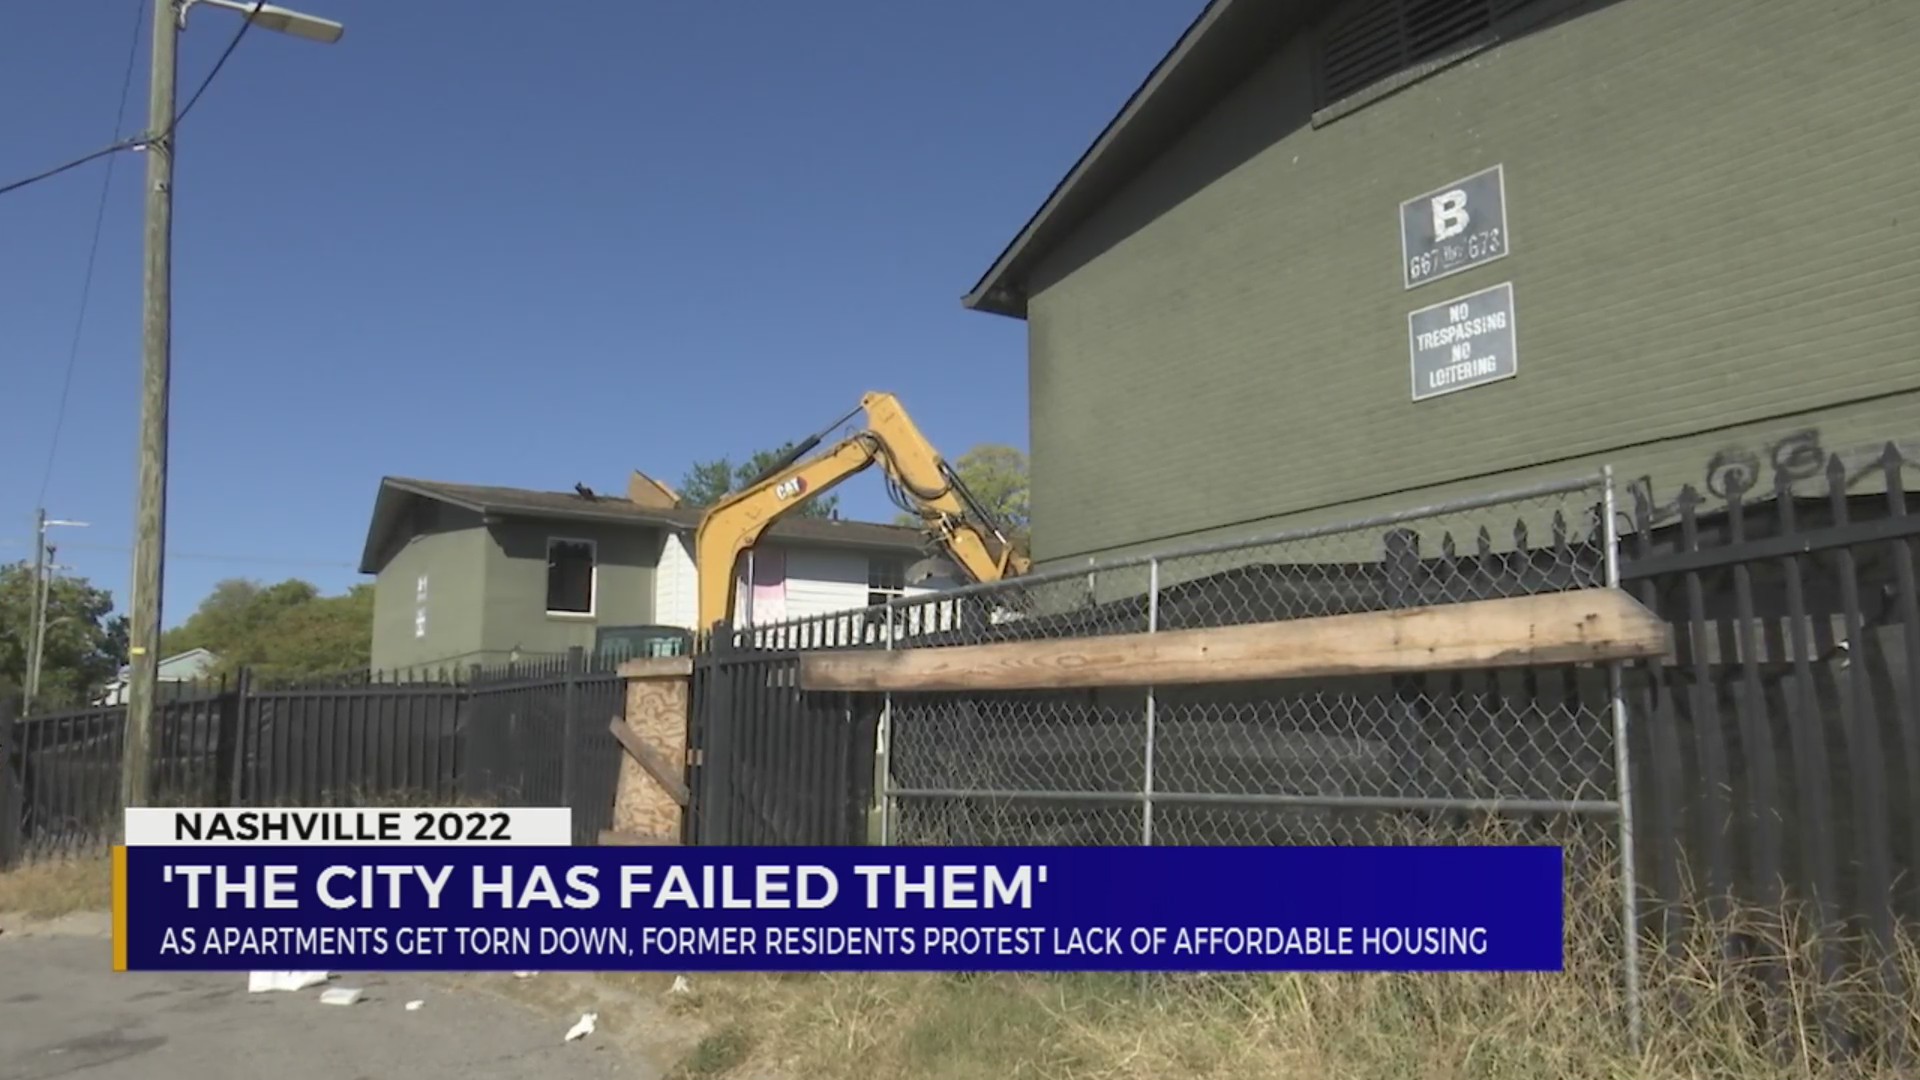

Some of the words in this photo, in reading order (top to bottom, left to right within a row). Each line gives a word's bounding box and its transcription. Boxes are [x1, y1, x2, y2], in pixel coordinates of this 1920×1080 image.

[1431, 189, 1470, 242] B
[1410, 249, 1439, 279] 667
[1468, 228, 1500, 259] 673
[1450, 303, 1469, 324] NO
[1417, 311, 1506, 351] TRESPASSING
[1451, 342, 1471, 362] NO
[1429, 355, 1497, 388] LOITERING
[776, 477, 800, 500] CAT
